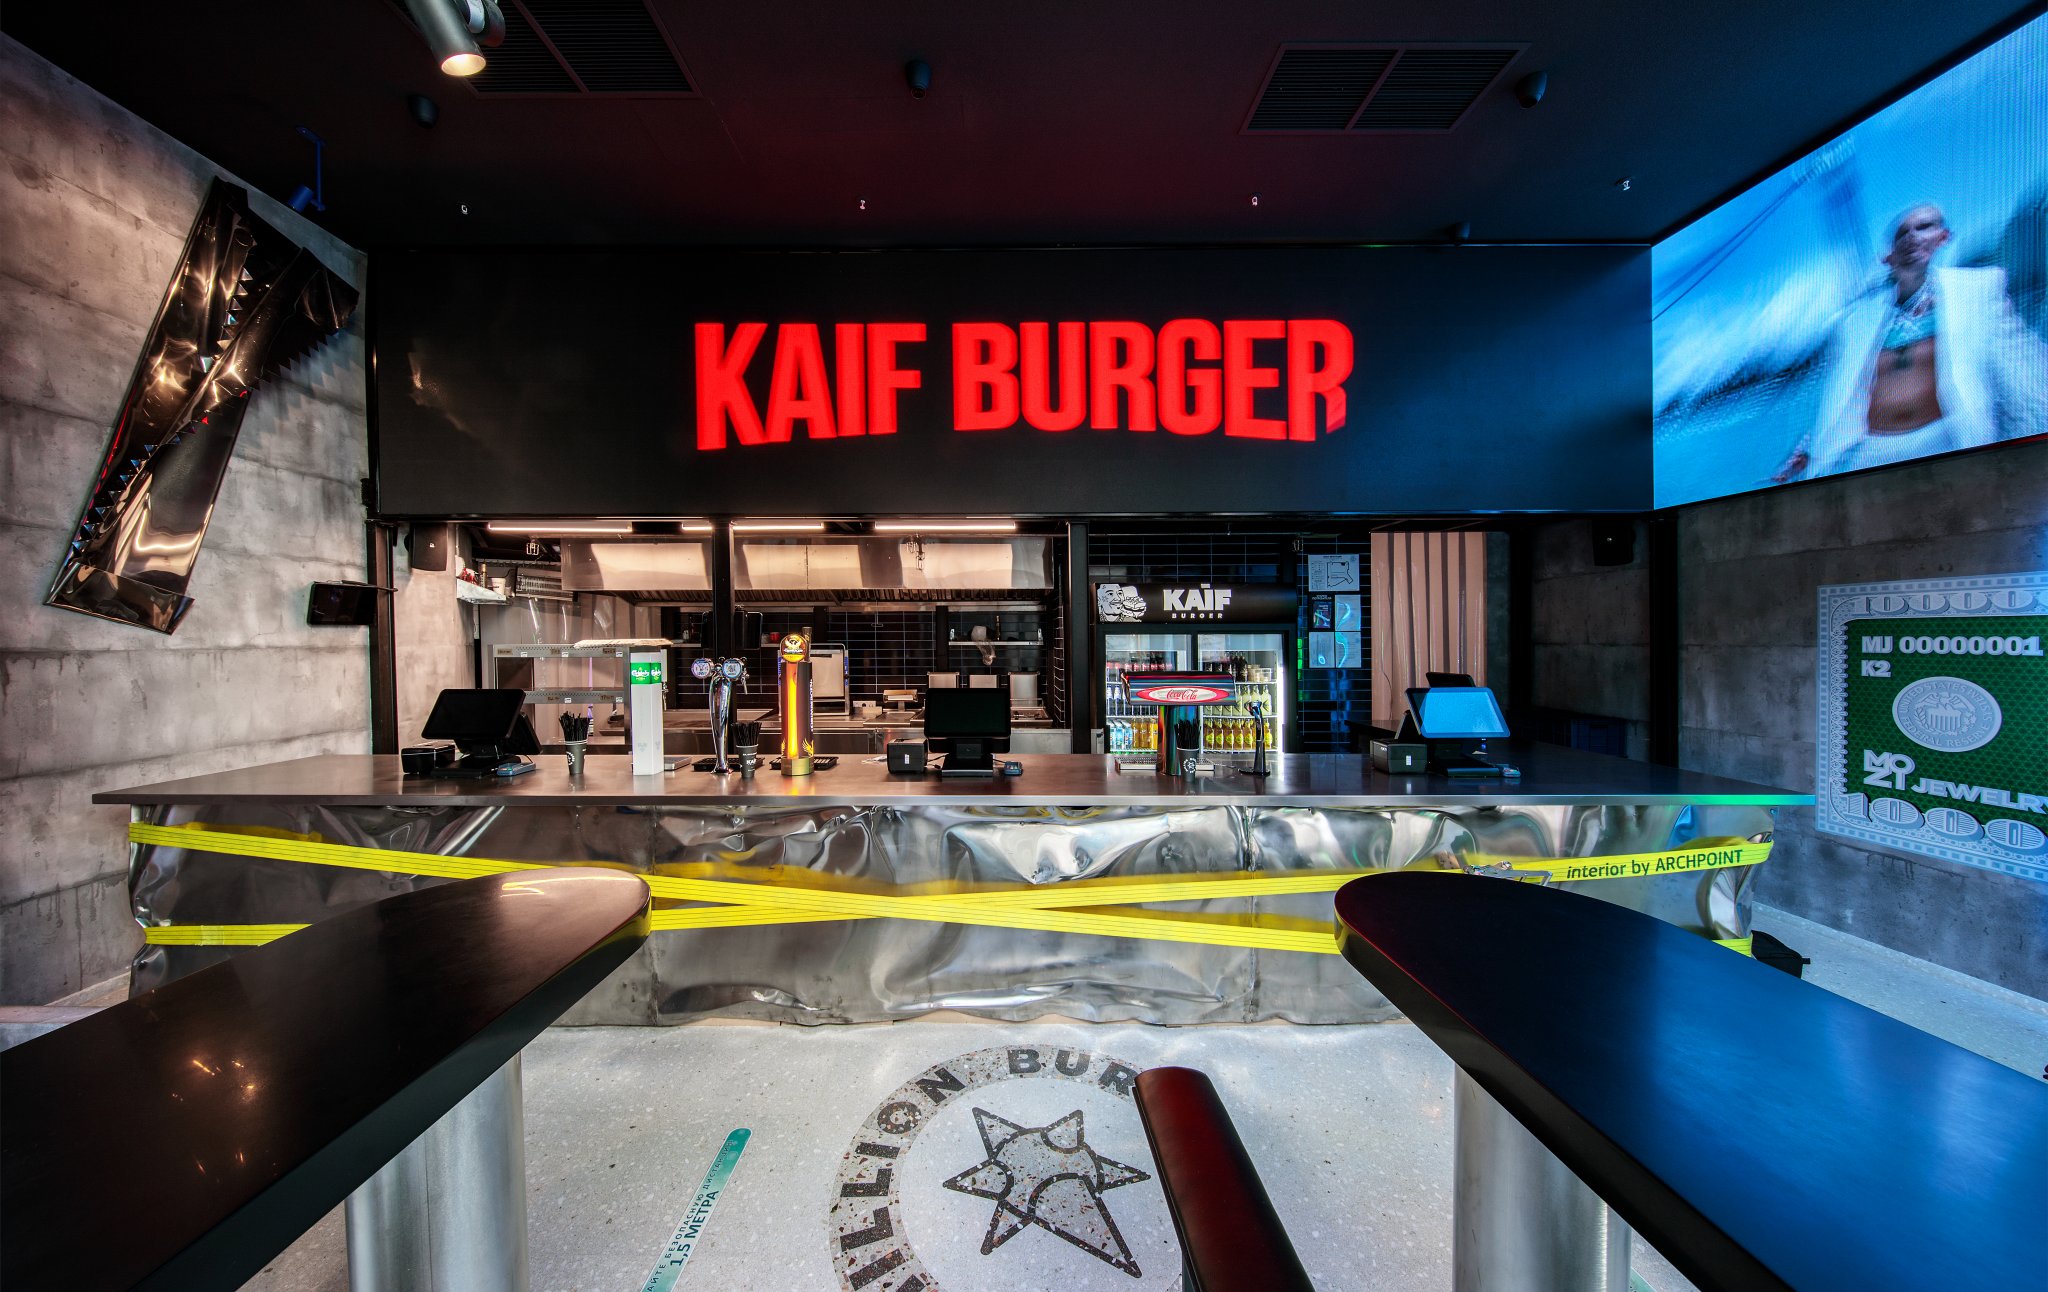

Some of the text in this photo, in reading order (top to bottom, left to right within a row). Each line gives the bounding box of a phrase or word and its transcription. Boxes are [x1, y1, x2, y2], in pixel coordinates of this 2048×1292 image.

[695, 318, 1355, 450] KAIF BURGER
[1861, 635, 2044, 657] MJ 00000001
[1861, 659, 1891, 677] K2
[1899, 686, 1924, 713] UNITED
[1566, 849, 1743, 879] interior by ARCHPOINT
[665, 1193, 704, 1258] БЕЗОПАСНУЮ
[670, 1190, 719, 1266] 1,5 МЕТРА
